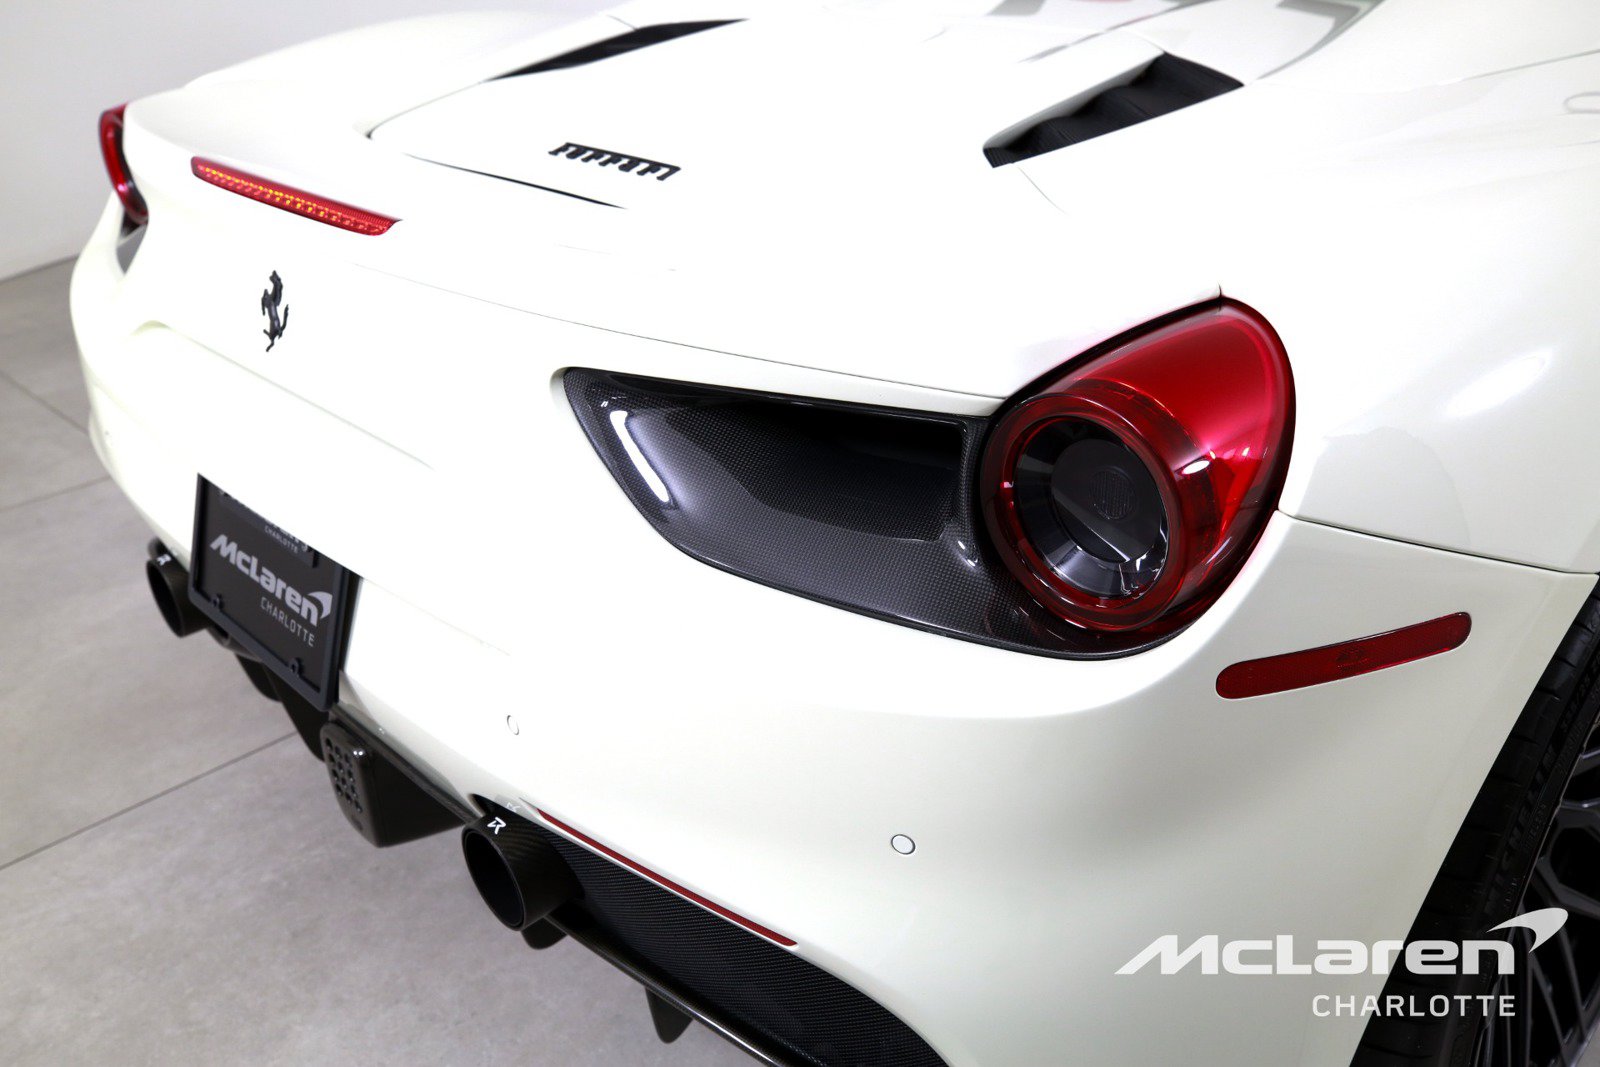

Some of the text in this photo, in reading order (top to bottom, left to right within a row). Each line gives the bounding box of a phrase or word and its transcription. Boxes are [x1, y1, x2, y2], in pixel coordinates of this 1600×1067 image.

[548, 142, 681, 181] Ferrari
[210, 534, 319, 627] McLaren
[260, 596, 315, 648] CHARLOTTE
